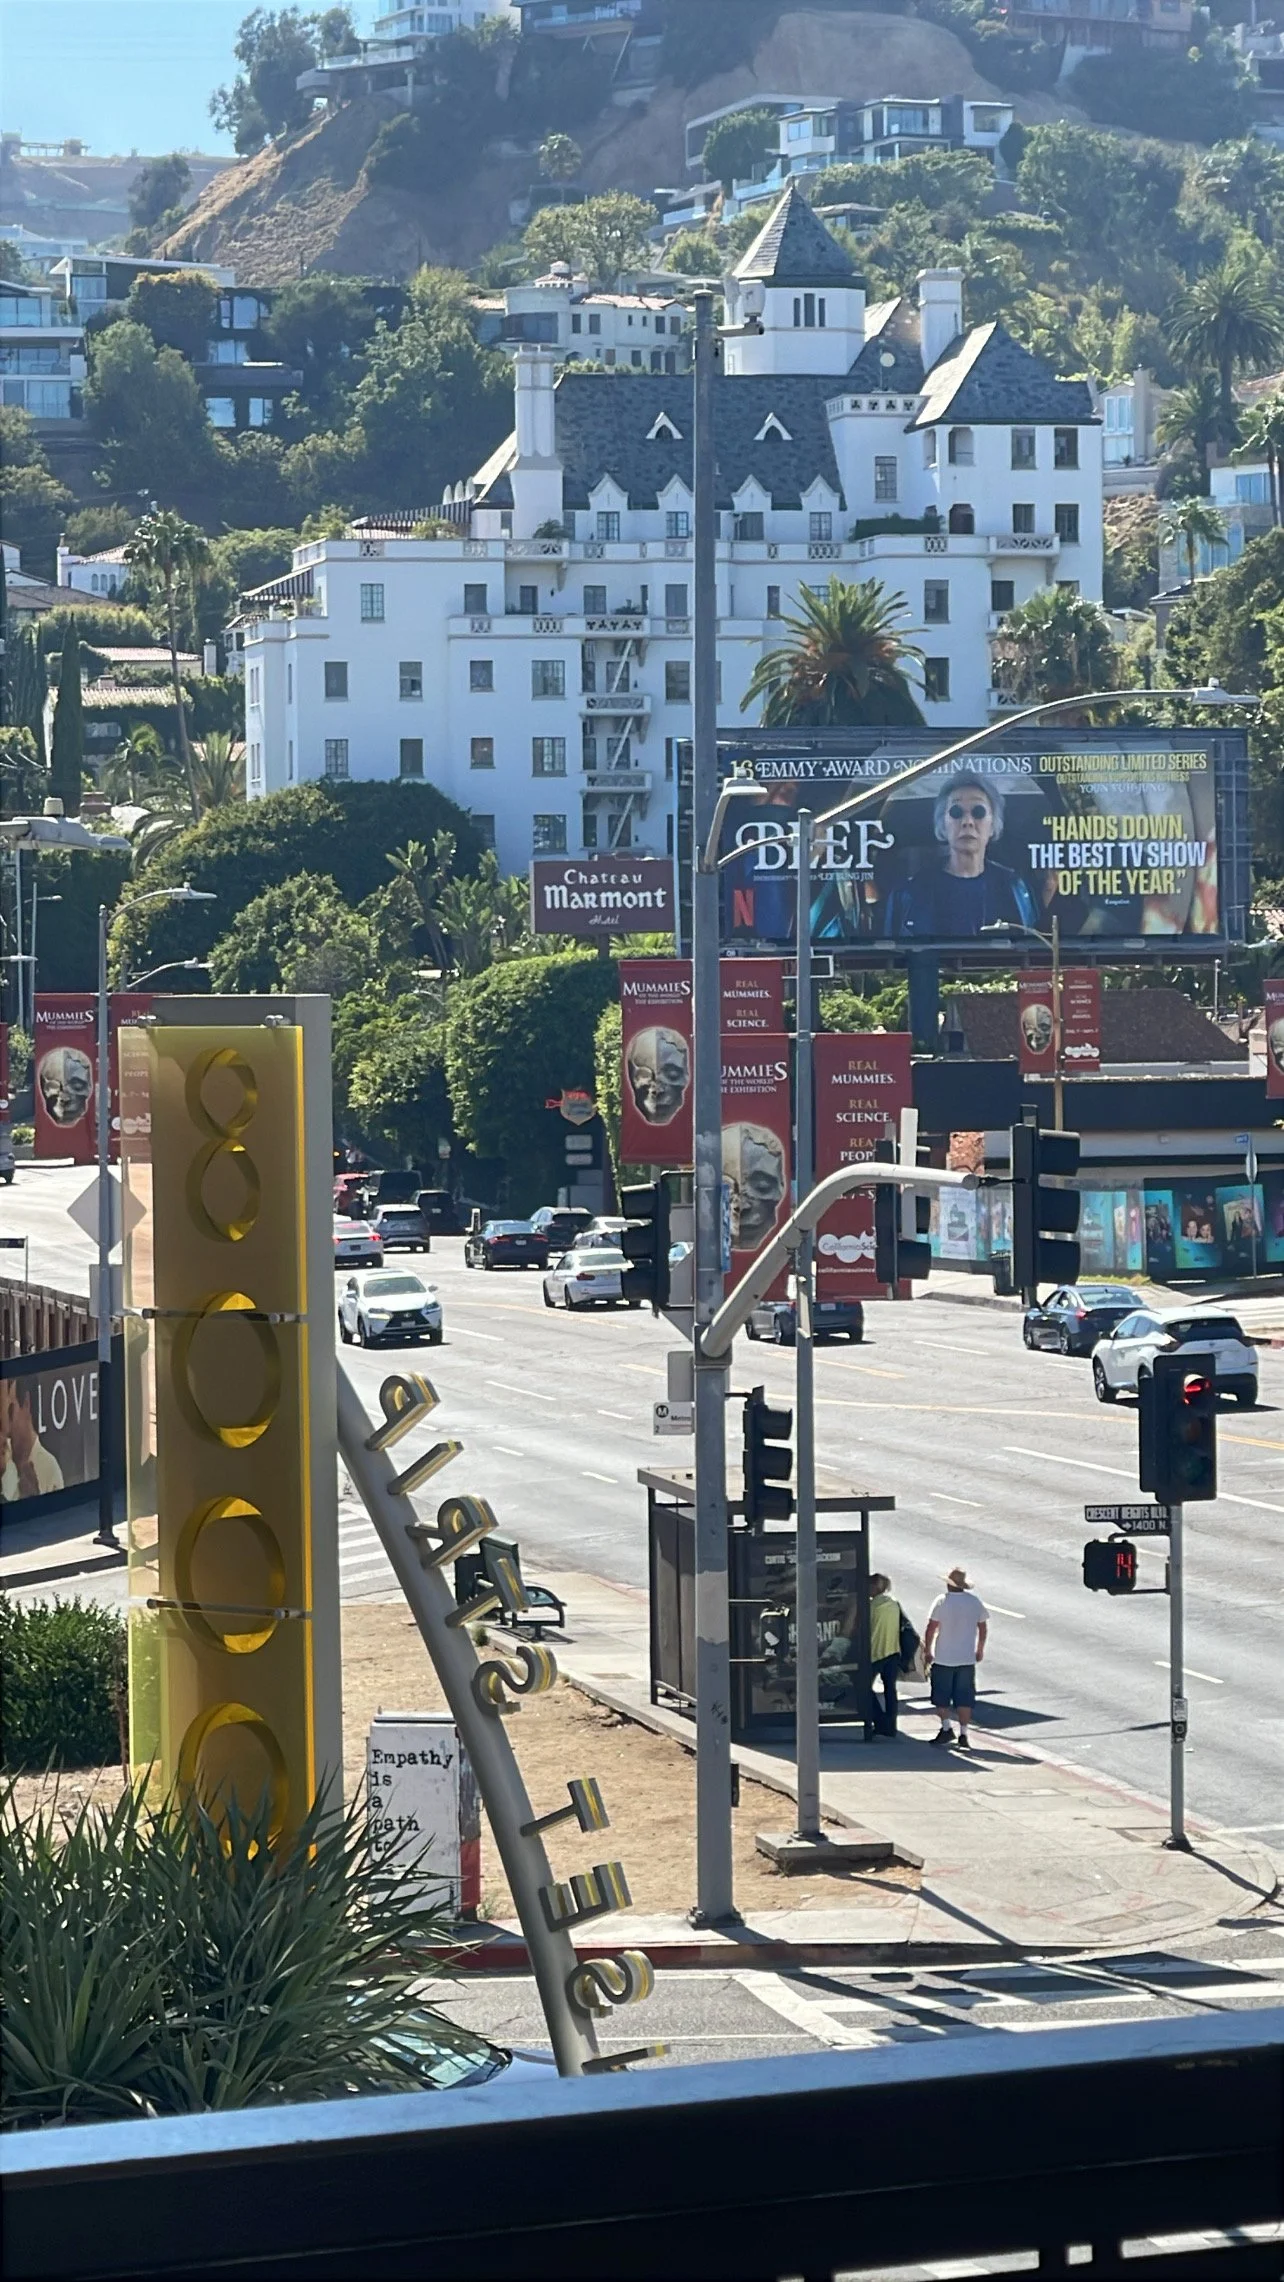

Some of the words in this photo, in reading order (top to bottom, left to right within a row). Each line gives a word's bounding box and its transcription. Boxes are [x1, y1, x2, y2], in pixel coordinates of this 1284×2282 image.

[823, 759, 890, 776] AWARD
[1039, 755, 1119, 773] OUTSTANDING
[1121, 754, 1166, 771] LIMITED
[1168, 752, 1207, 771] SERIES
[1056, 772, 1107, 784] OUTSTANDING
[1121, 814, 1188, 842] DOWN,
[1028, 843, 1065, 869] THE
[1068, 842, 1116, 869] BEST
[1118, 841, 1144, 868] TV
[1147, 840, 1207, 868] SHOW
[563, 868, 642, 885] Chateau
[1058, 870, 1083, 896] OF
[1086, 869, 1123, 895] THE
[543, 884, 667, 909] Marmont
[733, 889, 754, 927] N
[623, 980, 691, 996] MUMMIES
[735, 980, 759, 988] REAL
[722, 989, 772, 998] MUMMIES.
[36, 1009, 94, 1023] MUMMIES
[736, 1009, 759, 1017] REAL
[726, 1019, 769, 1028] SCIENCE.
[847, 1060, 878, 1070] REAL
[831, 1074, 897, 1084] MUMMIES.
[730, 1085, 777, 1093] EXHIBITION
[848, 1099, 879, 1108] REAL
[835, 1112, 893, 1123] SCIENCE.
[849, 1137, 874, 1147] REA
[840, 1150, 874, 1162] PEOP
[38, 1372, 98, 1434] LOVE
[1086, 1506, 1120, 1520] CRESCENT
[1121, 1506, 1149, 1519] HEIGHTS
[1132, 1520, 1156, 1530] 1400
[1116, 1552, 1133, 1579] 14
[372, 1749, 453, 1769] Empathy
[372, 1771, 392, 1787] is
[372, 1796, 383, 1808] a
